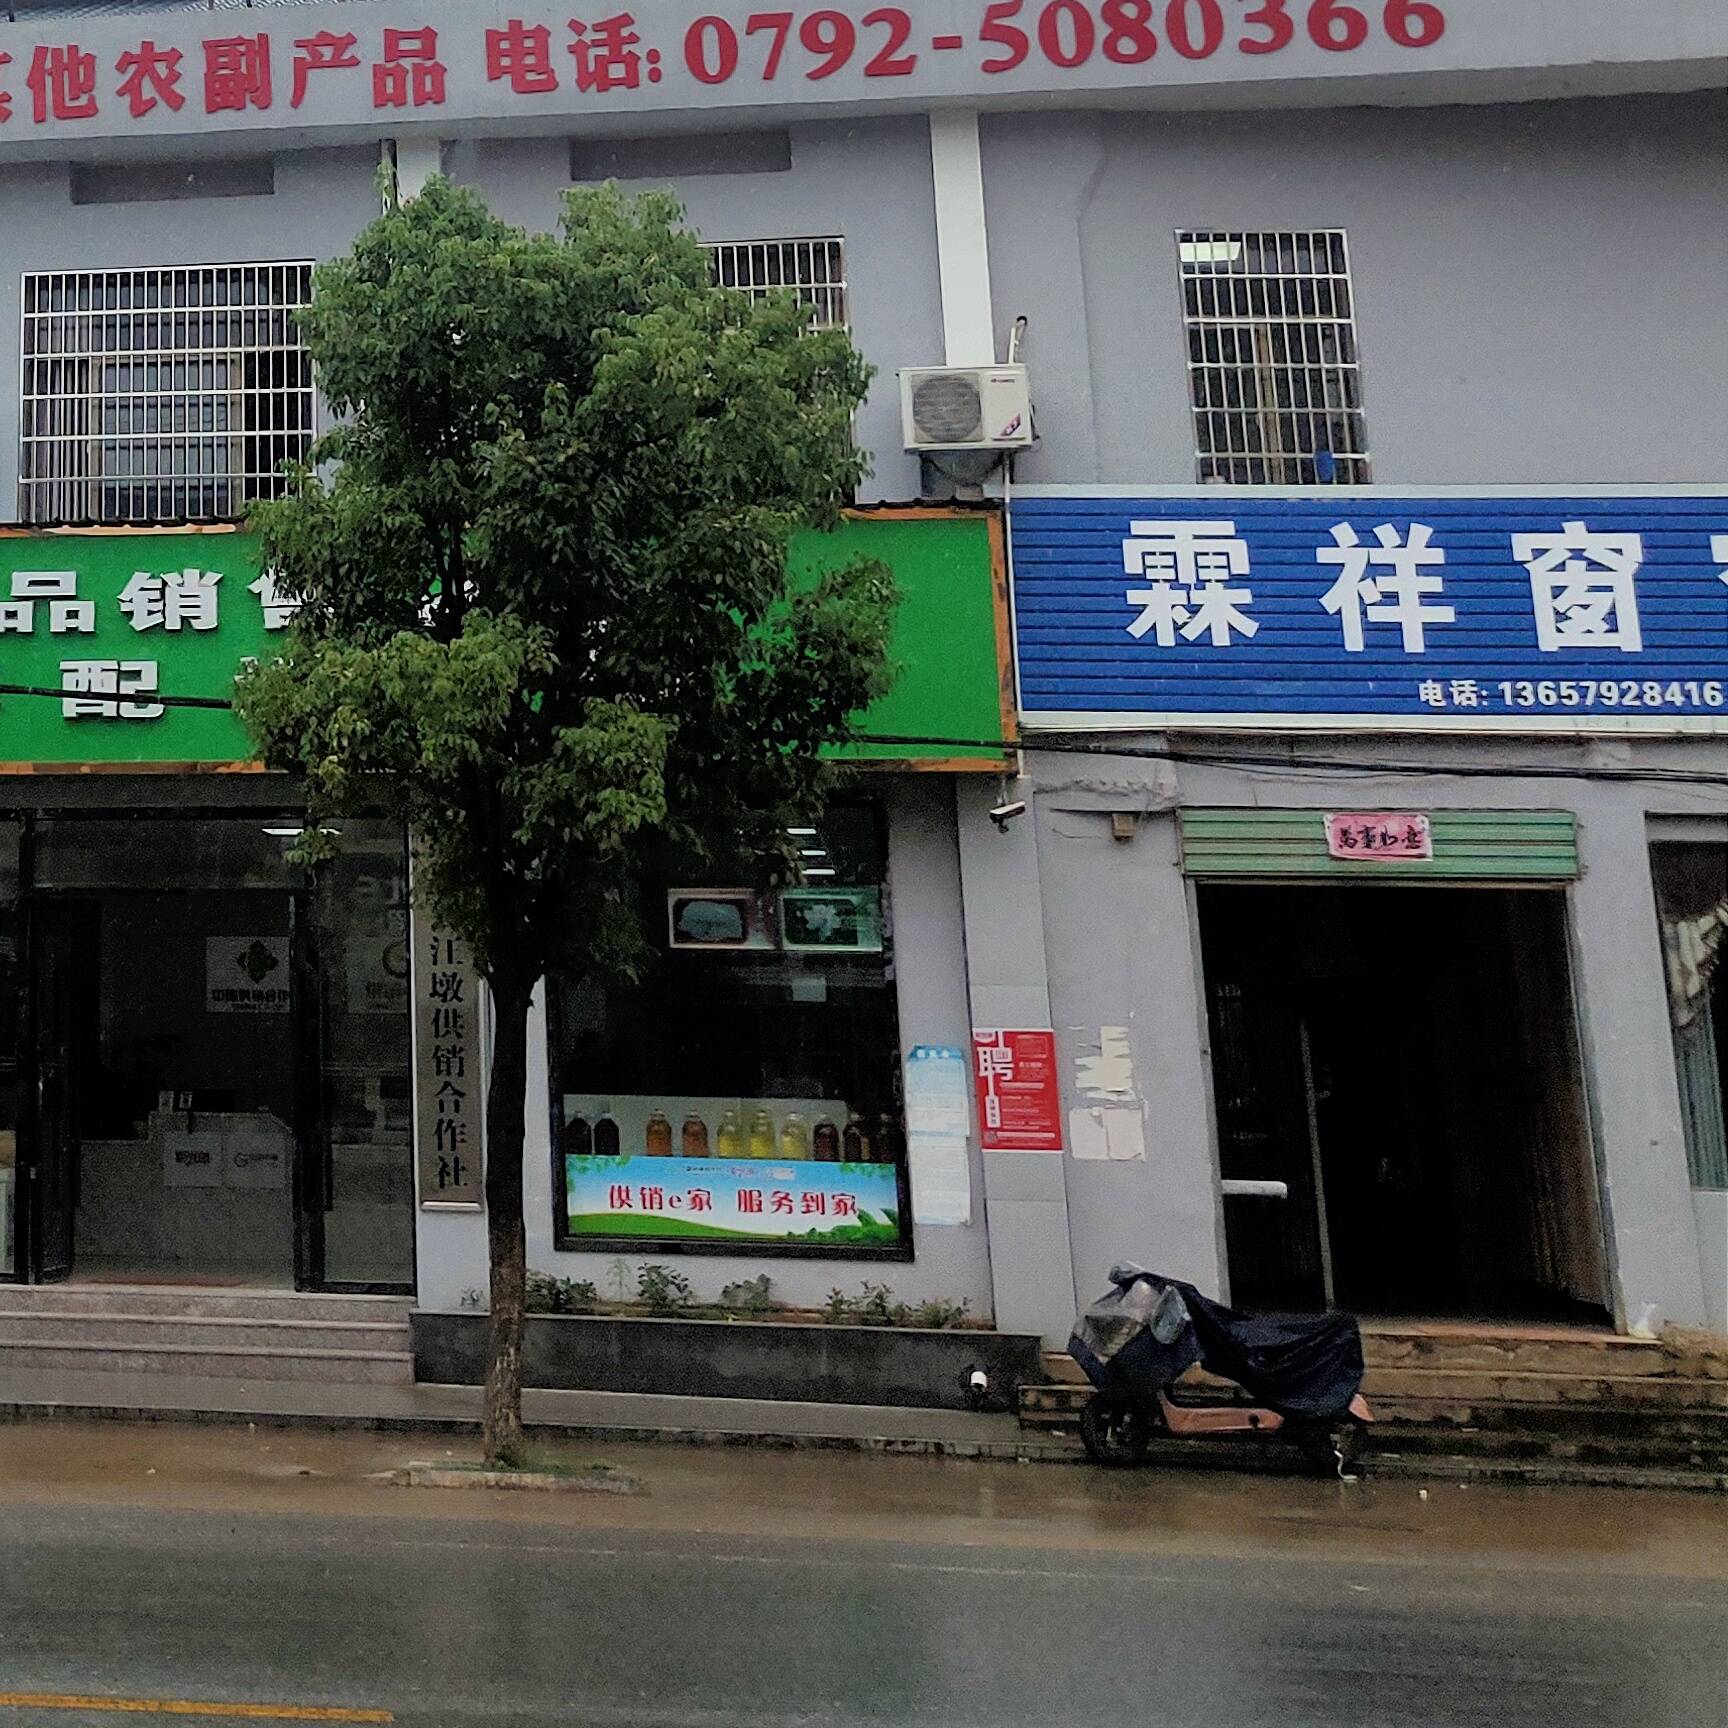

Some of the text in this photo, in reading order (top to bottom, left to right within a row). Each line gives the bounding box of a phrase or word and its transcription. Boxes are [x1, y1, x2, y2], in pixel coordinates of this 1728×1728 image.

[1122, 520, 1728, 654] 霖祥窗
[1498, 680, 1725, 707] 13657928416
[608, 1184, 859, 1217] 供销e家 服务到家
